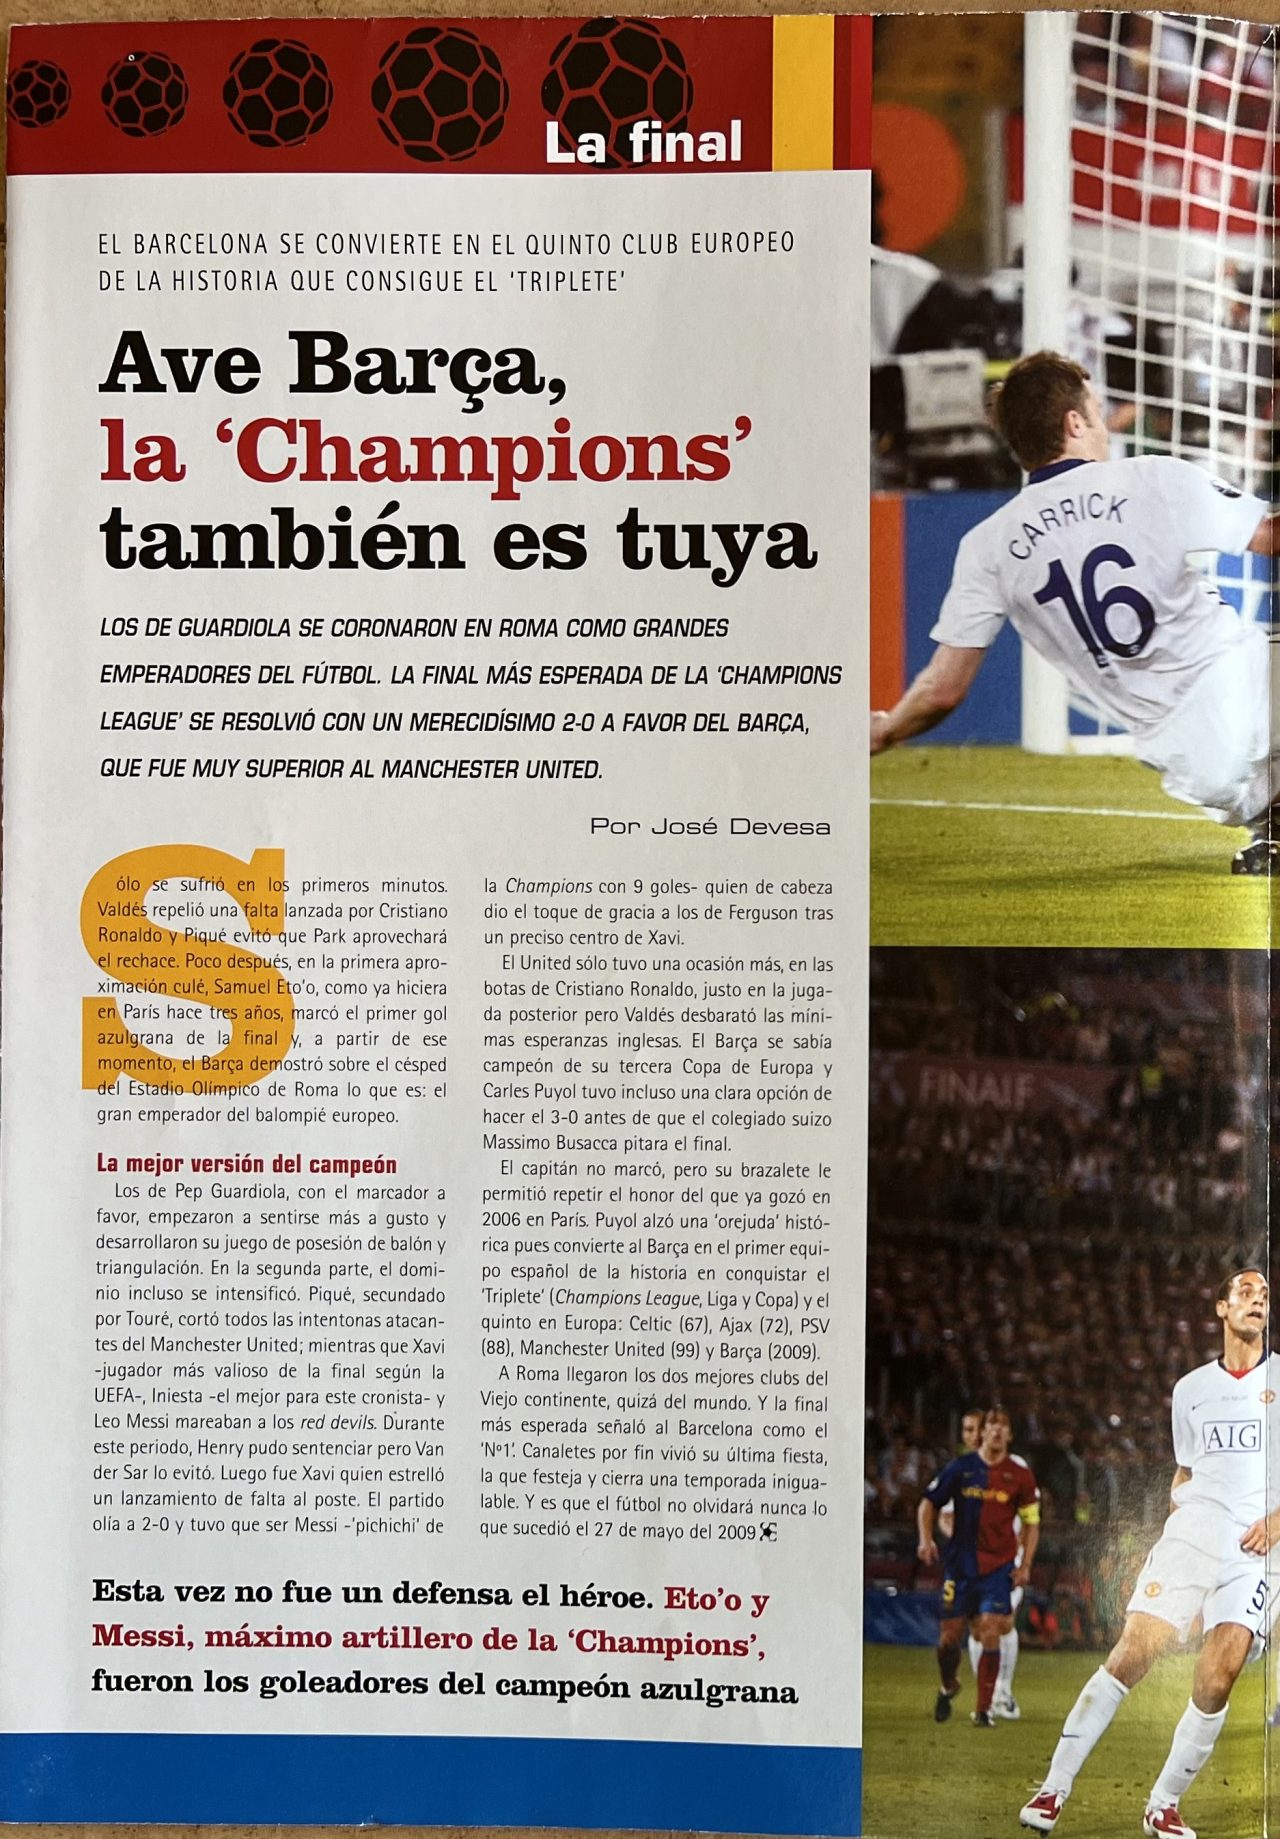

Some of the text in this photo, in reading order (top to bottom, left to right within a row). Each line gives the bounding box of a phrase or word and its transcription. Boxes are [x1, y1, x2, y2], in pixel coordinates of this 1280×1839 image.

[546, 119, 742, 164] La final
[98, 230, 794, 256] EL BARCELONA SE CONVIERTE EN EL QUINTO CLUB EUROPEO
[99, 269, 625, 292] DE LA HISTORIA QUE CONSIGUE EL 'TRIPLETE'
[98, 330, 567, 415] Ave Barça,
[100, 415, 752, 501] la ‘Champions’
[1008, 492, 1128, 560] CARRICK
[99, 499, 819, 589] también es tuya
[1033, 543, 1156, 668] 16
[100, 617, 730, 638] LOS DE GUARDIOLA SE CORONARON EN ROMA COMO GRANDES
[99, 660, 843, 685] EMPERADORES DEL FÚTBOL. LA FINAL MÁS ESPERADA DE LA ‘CHAMPIONS
[100, 757, 603, 779] QUE FUE MUY SUPERIOR AL MANCHESTER UNITED.
[590, 816, 831, 836] Por José Devesa
[97, 1106, 399, 1127] gran emperador del balompié europeo.
[97, 1152, 397, 1179] La mejor versión del campeón
[1206, 1424, 1257, 1450] AIG
[480, 1519, 756, 1542] que sucedió el 27 de mayo del 2009
[92, 1578, 771, 1619] Esta vez no fue un defensa el héroe. Eto’o y
[91, 1622, 766, 1662] Messi, máximo artillero de la ‘Champions’,
[90, 1668, 800, 1709] fueron los goleadores del campeón azulgrana
